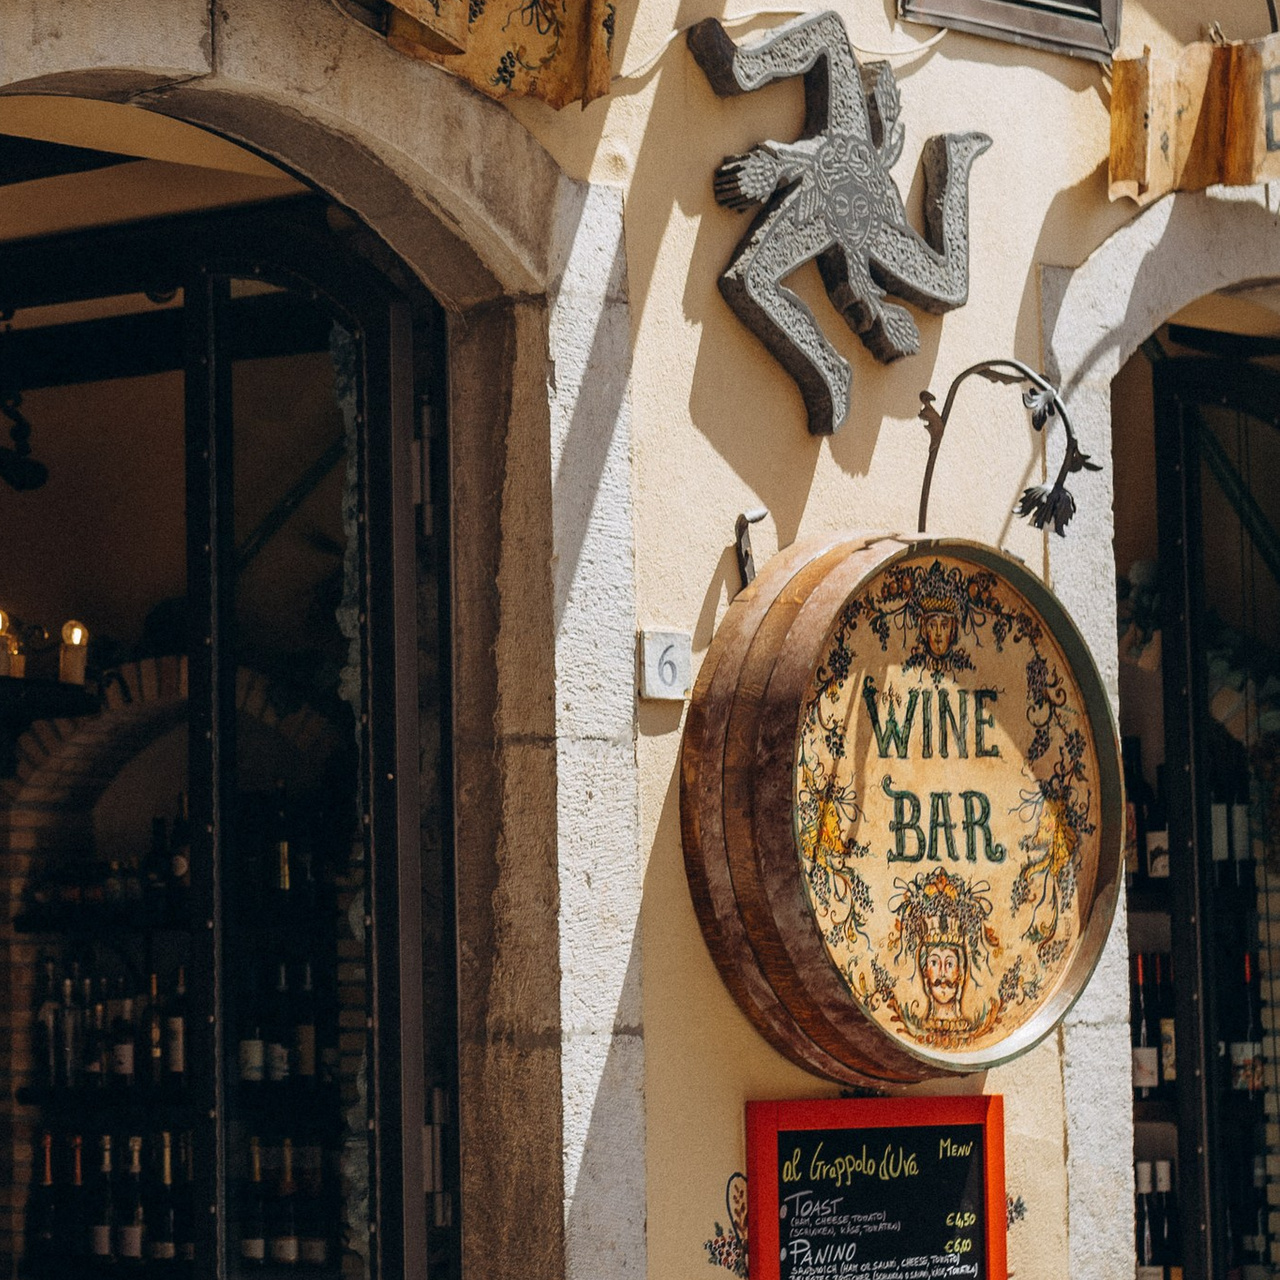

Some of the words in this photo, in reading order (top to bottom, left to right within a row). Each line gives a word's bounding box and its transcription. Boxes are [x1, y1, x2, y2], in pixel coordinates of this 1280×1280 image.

[658, 644, 677, 687] 6
[862, 677, 1001, 760] WINE
[882, 774, 1007, 866] BAR
[783, 1147, 802, 1183] al
[810, 1141, 876, 1187] Grappolo
[784, 1190, 844, 1217] TOAST
[946, 1212, 976, 1229] €4,50
[788, 1239, 857, 1266] PANINO
